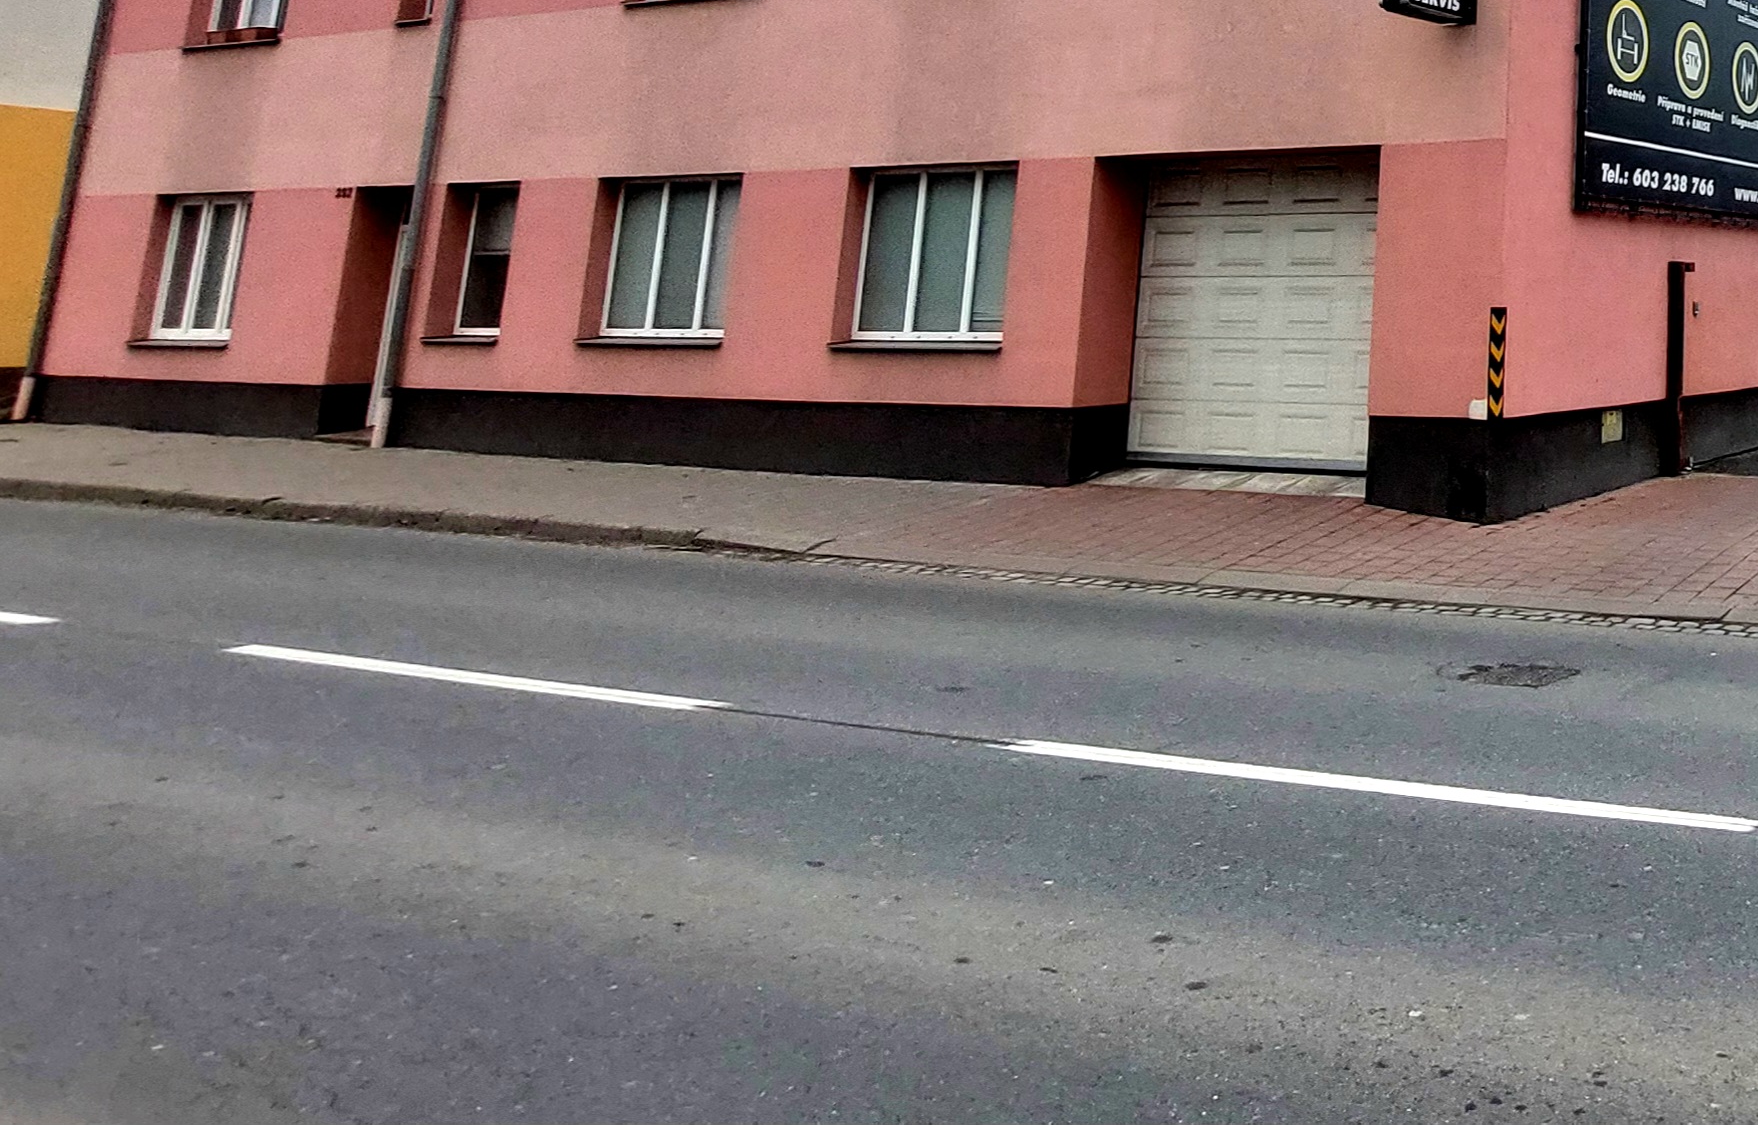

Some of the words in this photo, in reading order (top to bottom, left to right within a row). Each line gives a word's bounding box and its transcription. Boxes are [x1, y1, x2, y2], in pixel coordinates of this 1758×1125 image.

[1607, 83, 1646, 103] Geometrie
[1602, 163, 1628, 185] Tel.:
[1633, 168, 1659, 189] 603
[1662, 173, 1688, 193] 238
[1690, 177, 1715, 196] 766
